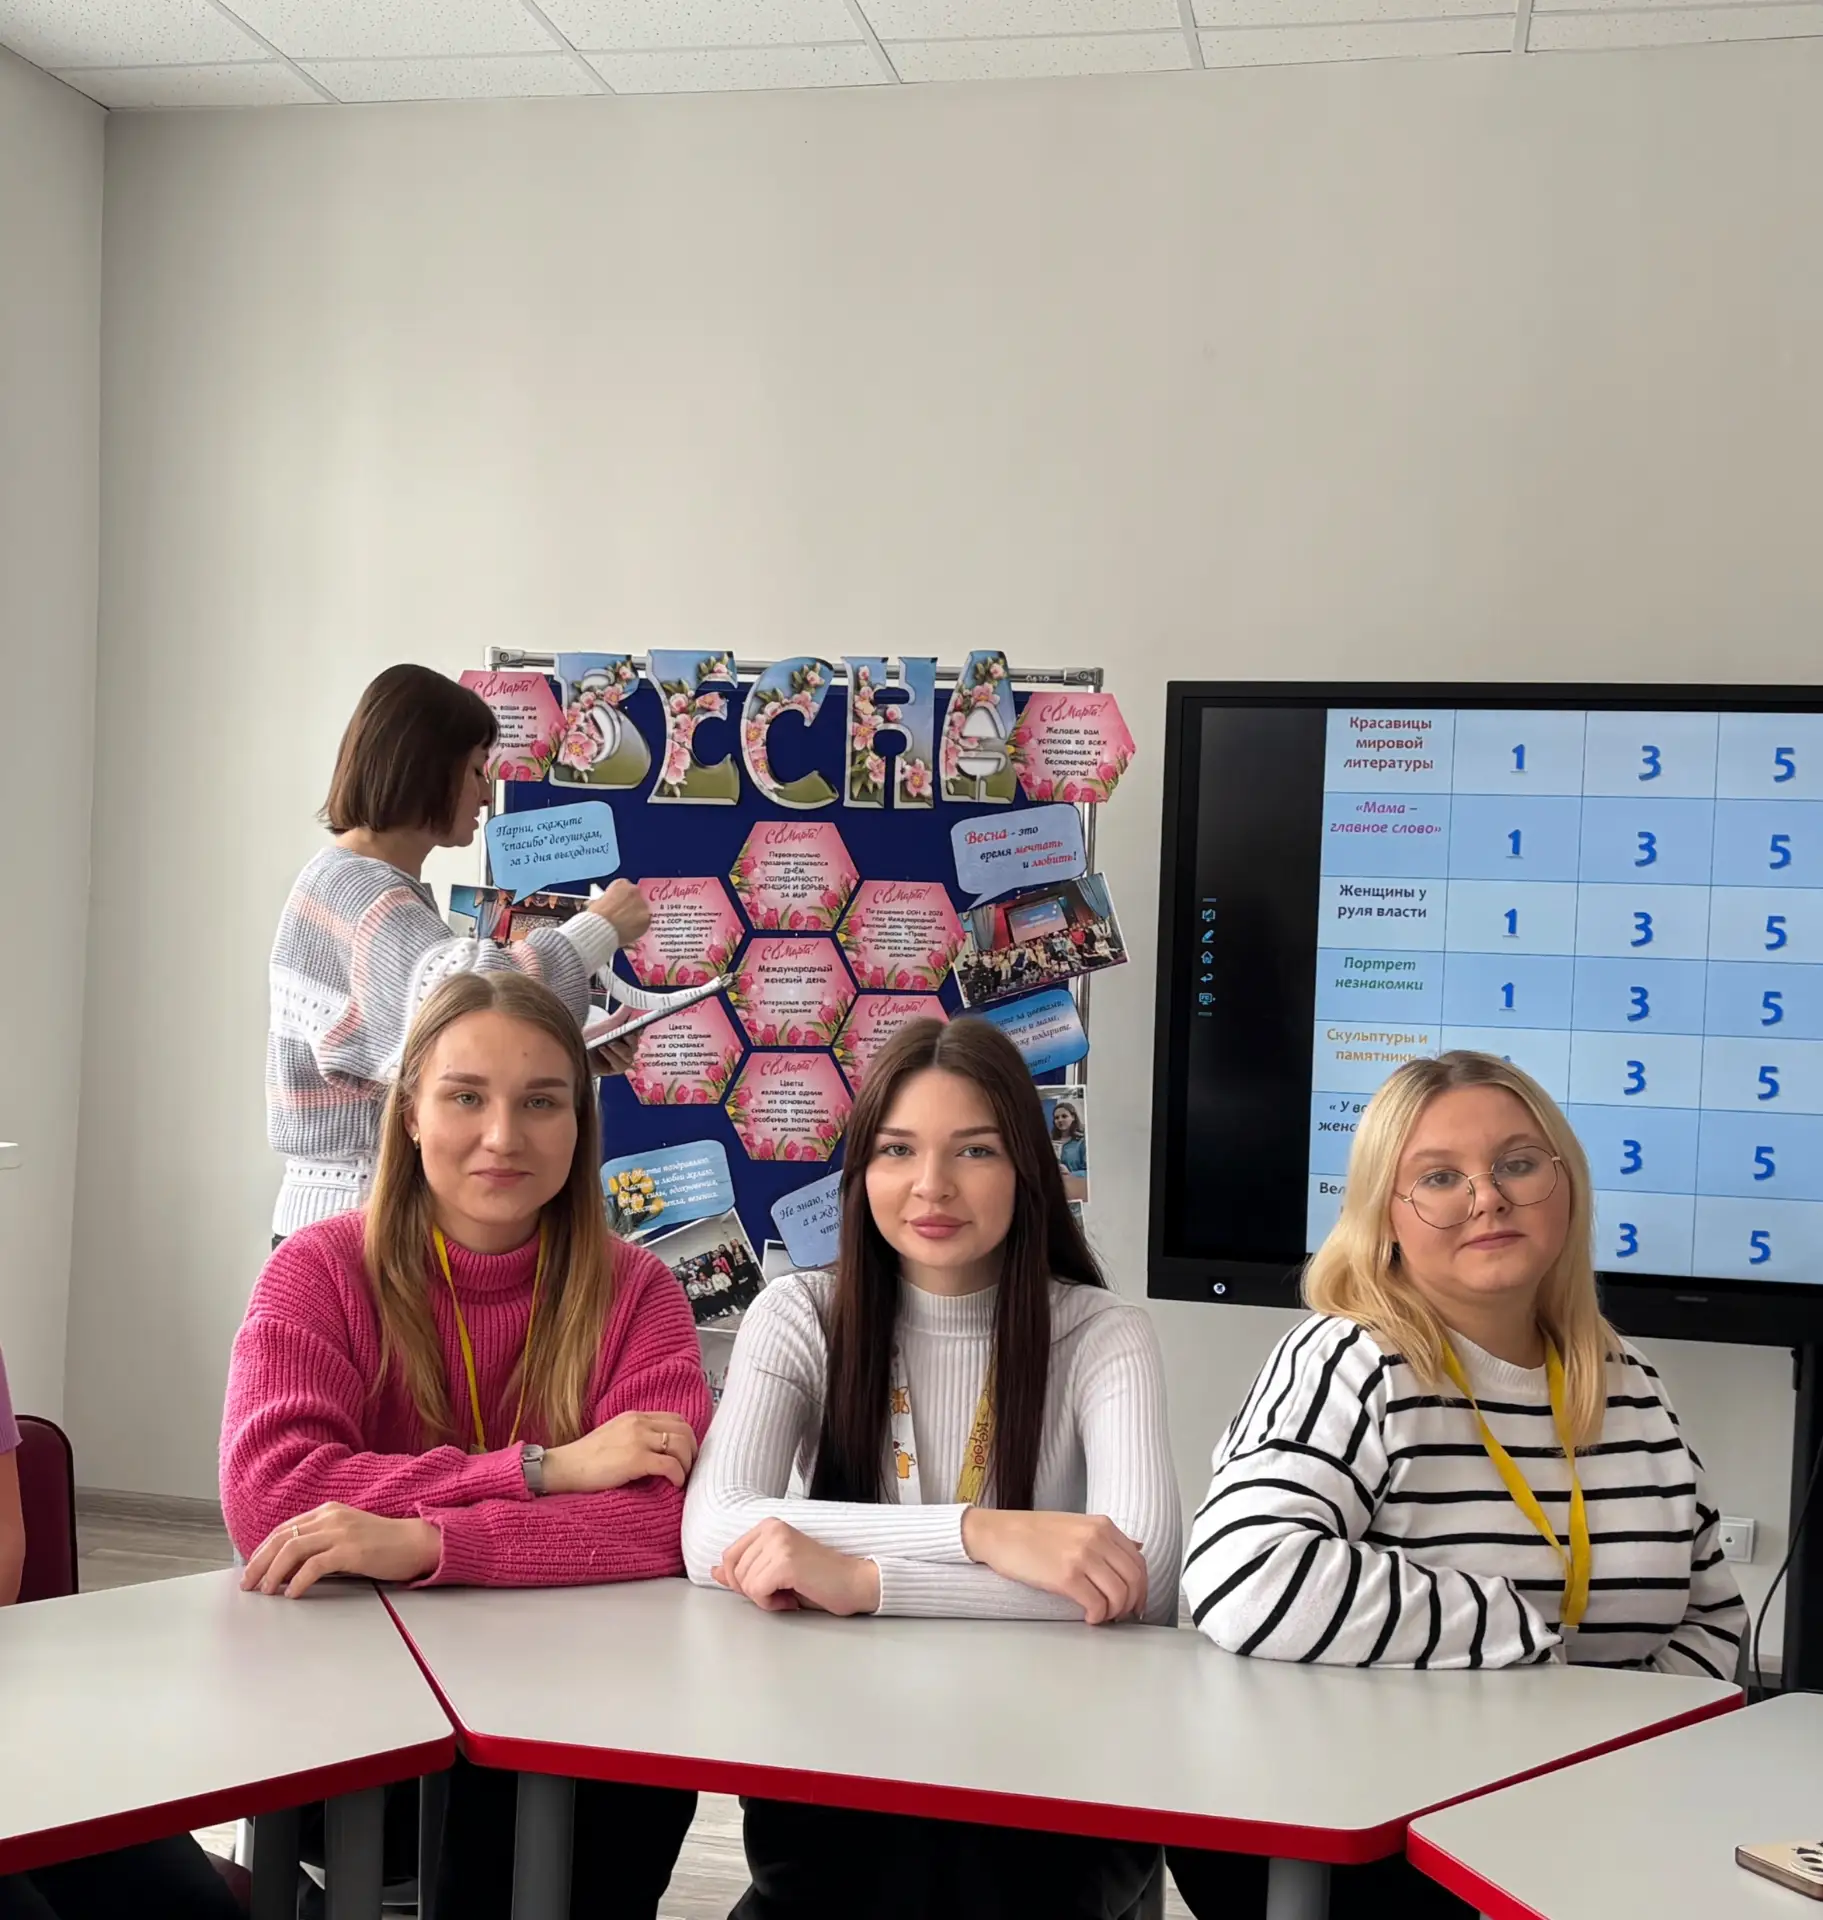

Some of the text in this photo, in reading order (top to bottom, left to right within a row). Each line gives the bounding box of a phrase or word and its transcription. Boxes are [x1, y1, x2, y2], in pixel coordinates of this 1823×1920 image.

[549, 649, 1018, 809] ВЕСНА
[1045, 726, 1081, 736] Желаем
[1349, 716, 1432, 732] Красавицы
[1037, 738, 1072, 746] успехов
[1042, 748, 1092, 756] начинаниях
[1356, 736, 1424, 752] мировой
[1044, 758, 1098, 766] бесконечной
[1343, 758, 1434, 772] литературы
[1511, 743, 1526, 771] 1
[1638, 745, 1661, 781] 3
[1773, 747, 1795, 783] 5
[1052, 768, 1089, 777] красоты!
[1355, 801, 1406, 814] «Мама
[496, 816, 583, 839] Парни, скажите
[549, 829, 603, 846] девушкам,
[964, 828, 1008, 845] Весна
[1018, 826, 1039, 837] это
[1330, 822, 1442, 834] главное слово»
[980, 840, 1064, 863] время мечтать
[1507, 829, 1522, 856] 1
[1634, 831, 1657, 867] 3
[1769, 834, 1792, 870] 5
[509, 842, 610, 867] за 3 дня выходных!
[1022, 851, 1077, 869] и любить!
[1339, 884, 1427, 901] Женщины у
[1337, 906, 1427, 919] руля власти
[1504, 908, 1518, 935] 1
[1630, 912, 1653, 947] 3
[1764, 915, 1787, 951] 5
[758, 964, 833, 975] Международный
[1343, 956, 1416, 973] Портрет
[764, 976, 802, 984] женский
[1335, 978, 1424, 990] незнакомки
[1501, 982, 1515, 1009] 1
[1627, 986, 1650, 1021] 3
[1761, 991, 1784, 1026] 5
[1326, 1028, 1428, 1046] Скульптуры и
[1623, 1060, 1646, 1095] 3
[1757, 1065, 1780, 1100] 5
[1340, 1100, 1349, 1112] У
[1317, 1121, 1356, 1133] женс
[1620, 1139, 1643, 1175] 3
[1753, 1146, 1776, 1181] 5
[779, 1206, 794, 1220] Не
[796, 1196, 824, 1213] знаю,
[803, 1218, 809, 1227] а
[812, 1215, 818, 1223] я
[1616, 1223, 1639, 1258] 3
[1749, 1230, 1771, 1265] 5
